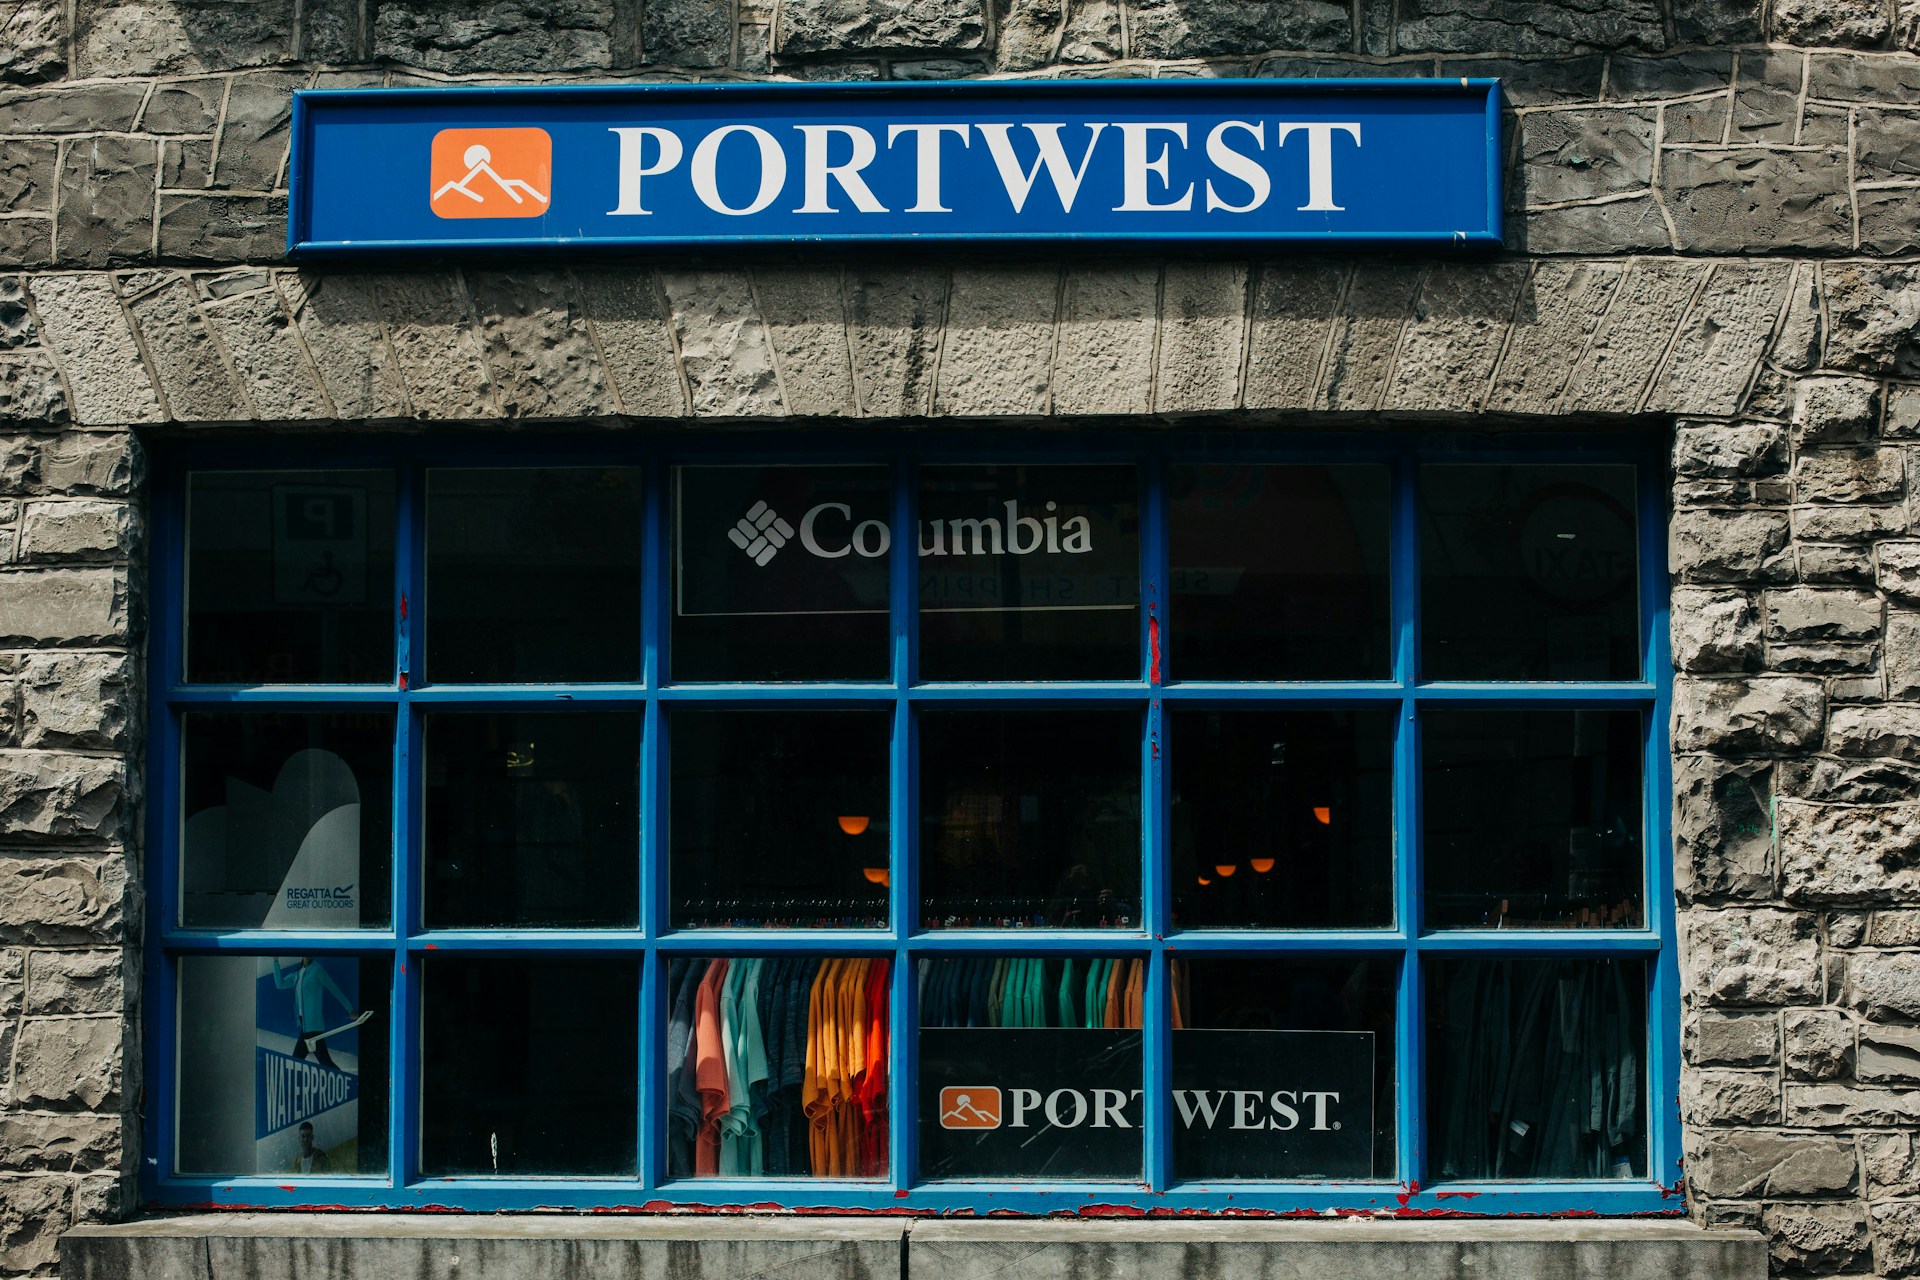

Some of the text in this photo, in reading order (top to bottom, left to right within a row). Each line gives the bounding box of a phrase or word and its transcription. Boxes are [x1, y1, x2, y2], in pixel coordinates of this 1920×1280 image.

[606, 120, 1361, 217] PORTWEST
[799, 499, 1093, 559] Coumbia
[287, 888, 331, 899] REGATTA
[287, 899, 354, 909] GREAT OUTDOORS
[265, 1052, 352, 1132] WATERPROOF
